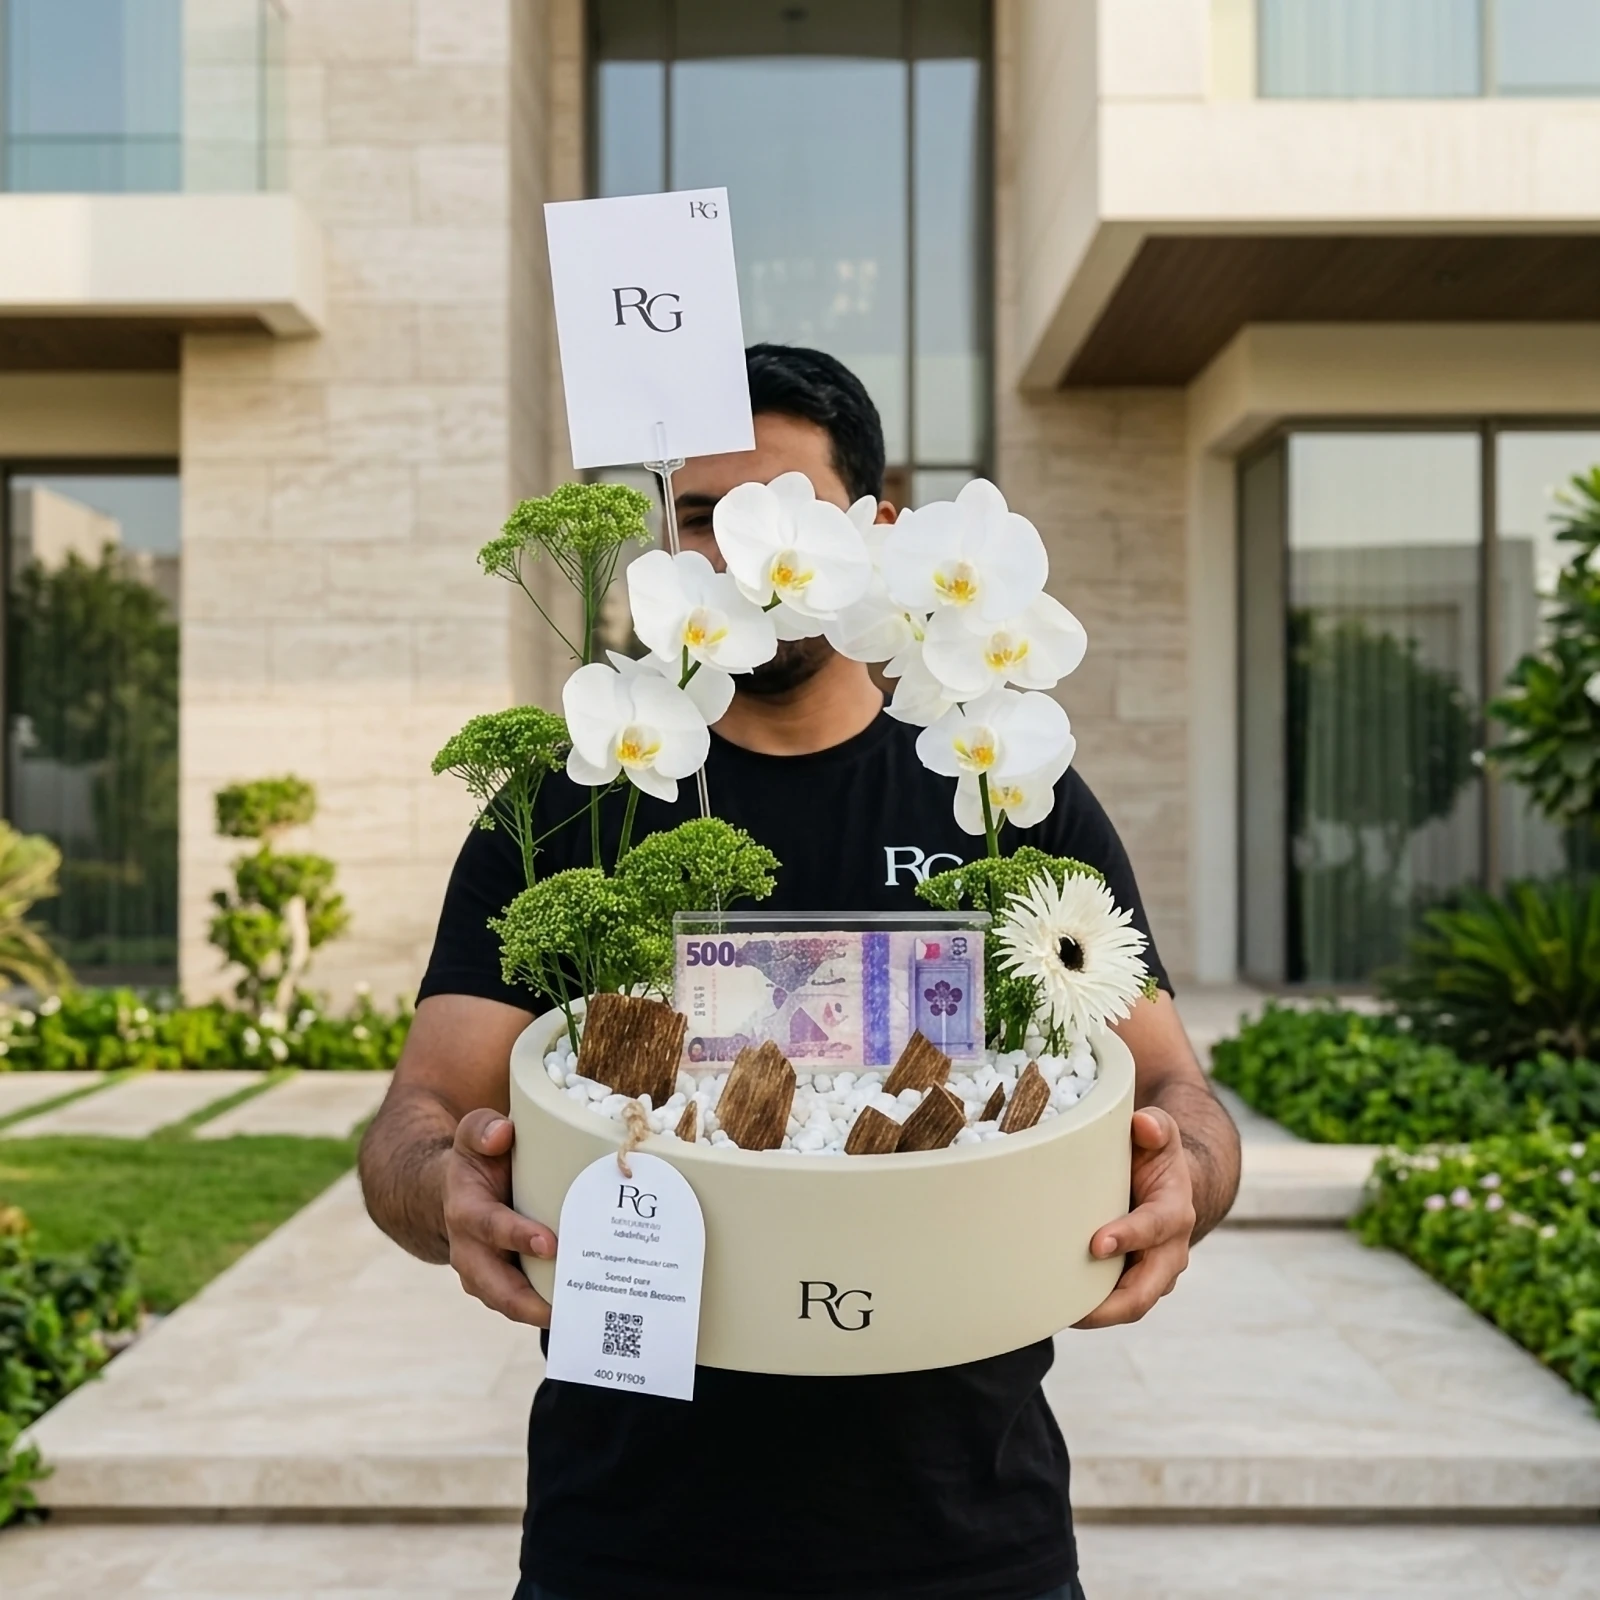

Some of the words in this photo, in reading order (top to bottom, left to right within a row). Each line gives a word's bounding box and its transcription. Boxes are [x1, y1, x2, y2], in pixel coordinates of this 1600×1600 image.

[689, 201, 718, 220] RG
[612, 286, 684, 333] RG
[686, 941, 735, 967] 500
[617, 1184, 658, 1219] RG
[798, 1280, 874, 1331] RG
[594, 1369, 614, 1381] 400
